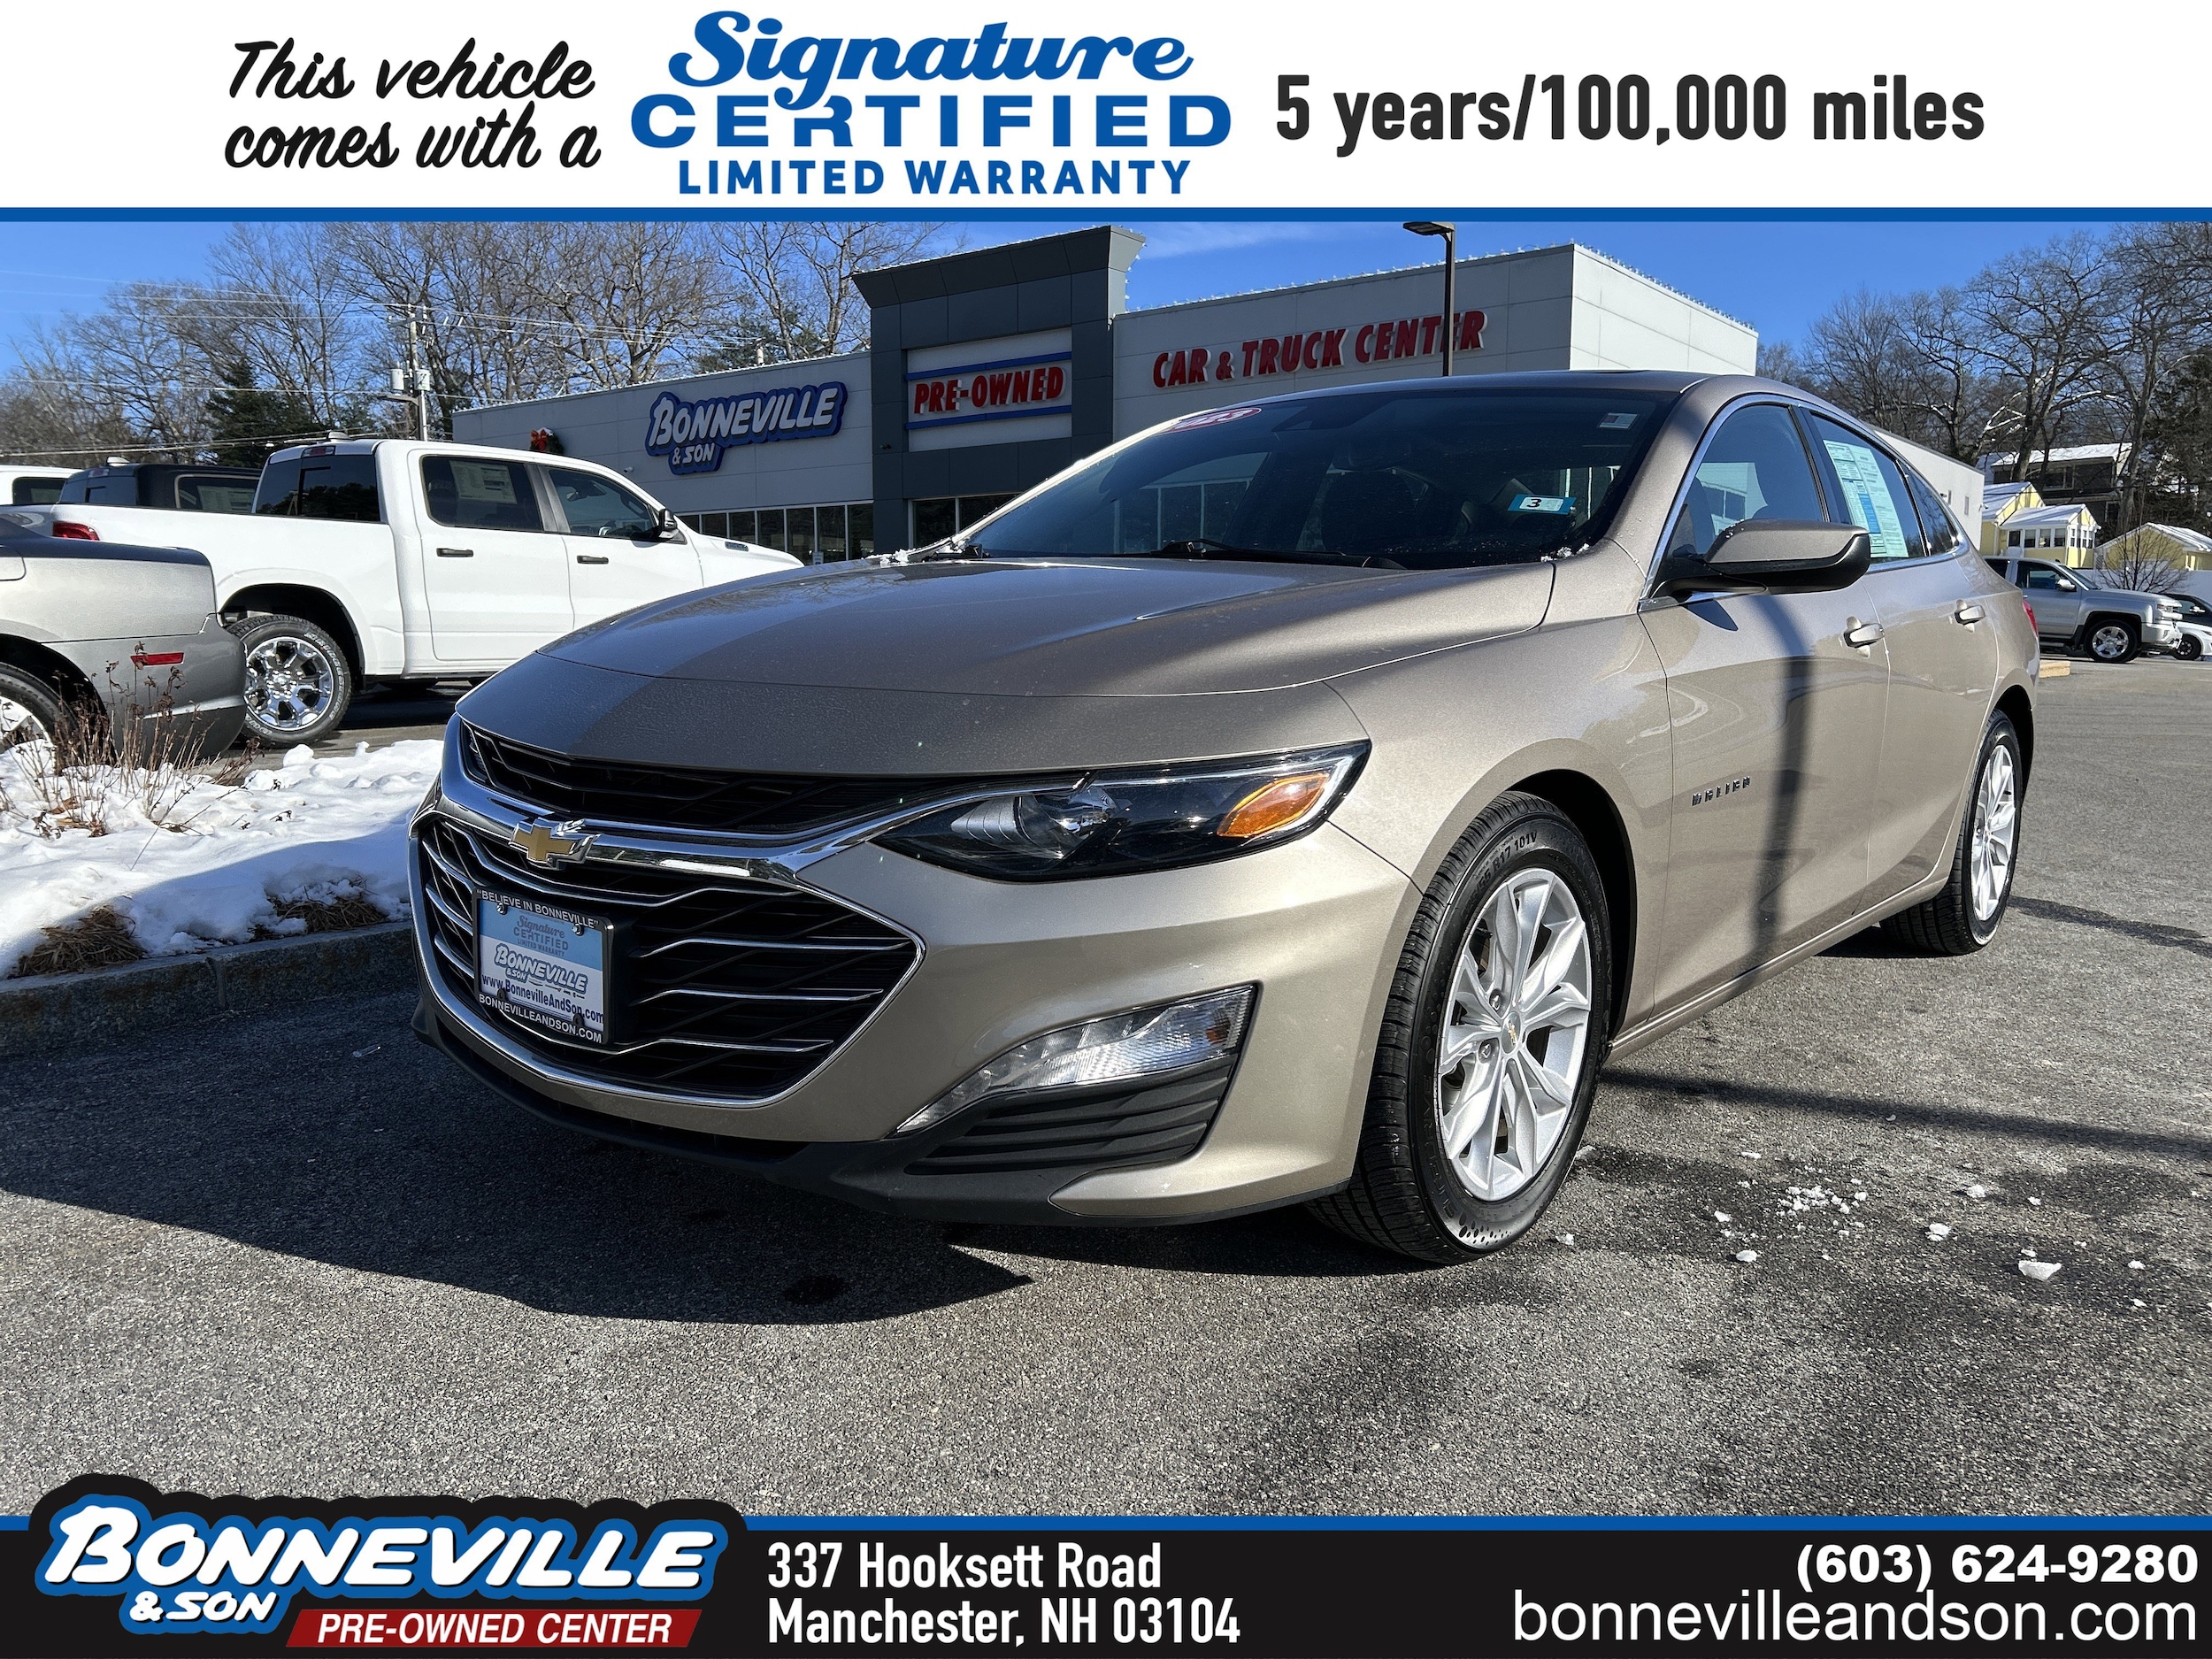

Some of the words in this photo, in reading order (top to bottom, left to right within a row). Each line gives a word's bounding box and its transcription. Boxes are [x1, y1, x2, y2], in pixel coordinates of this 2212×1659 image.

[1153, 348, 1211, 388] CAR
[1216, 351, 1235, 381] &
[1242, 328, 1349, 378] TRUCK
[914, 366, 1065, 415] PRE-OWNED
[649, 388, 839, 447] BONNEVILLE
[1526, 498, 1542, 508] 3
[517, 915, 565, 939] Signature
[523, 901, 533, 911] IN
[513, 927, 569, 951] CERTIFIED
[495, 944, 588, 992] BONNEVILLE
[479, 994, 602, 1043] BONNEVILLEANDSON.COM
